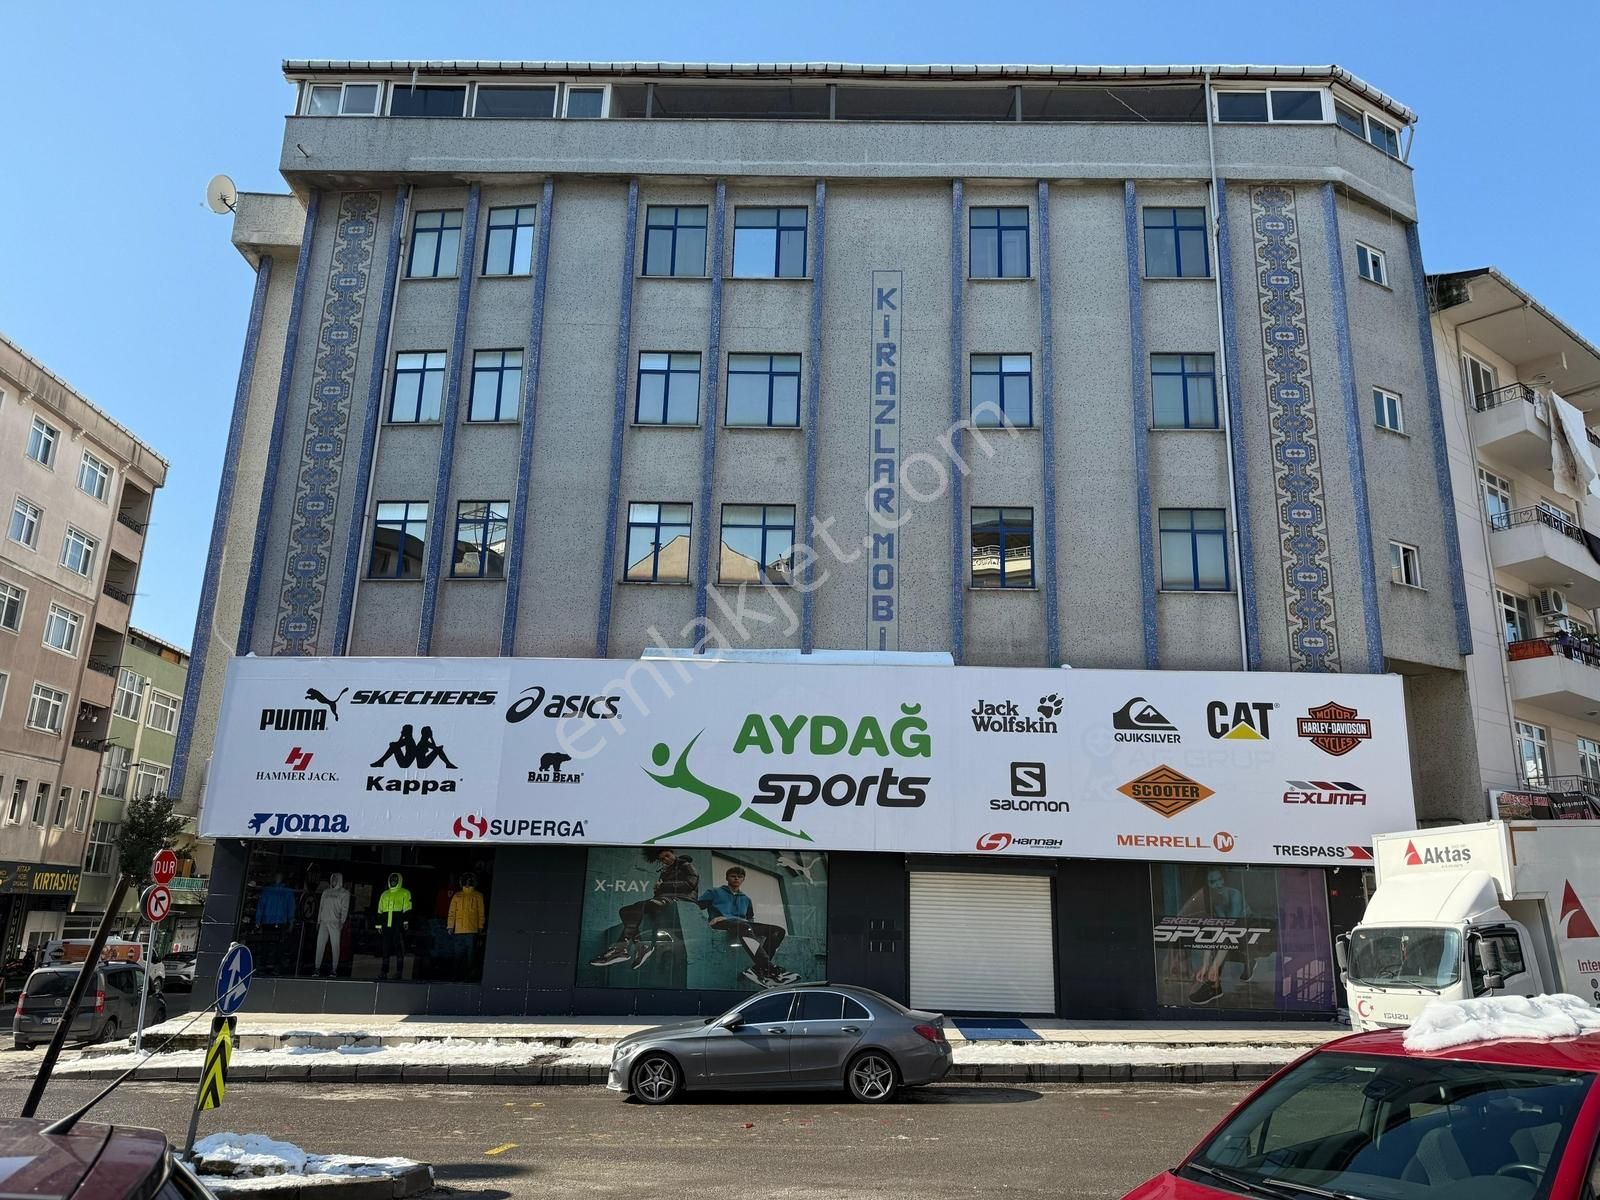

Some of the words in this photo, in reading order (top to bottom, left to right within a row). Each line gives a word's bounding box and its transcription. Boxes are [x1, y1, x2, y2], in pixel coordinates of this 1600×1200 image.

[350, 690, 498, 706] SKECHERS
[971, 699, 1019, 716] Jack
[1316, 706, 1351, 720] MOTOR
[259, 708, 328, 731] PUMA
[971, 715, 1058, 734] Wolfskin
[1206, 700, 1274, 740] CAT
[732, 702, 932, 758] AYDAĞ
[1301, 721, 1367, 735] HARLEY-DAVIDSON
[1113, 732, 1182, 744] QUIKSILVER
[1318, 737, 1353, 752] CYCLES
[256, 771, 306, 781] HAMMER
[307, 772, 337, 782] JACK
[365, 775, 457, 795] Kappa
[1131, 784, 1200, 798] SCOOTER
[750, 767, 932, 822] sports
[1282, 791, 1367, 806] EXUMA
[489, 819, 585, 837] SUPERGA
[1116, 834, 1211, 849] MERRELL
[1272, 844, 1346, 857] TRESPASS
[1423, 846, 1472, 865] Aktaş
[155, 860, 176, 874] DUR
[32, 869, 80, 891] KIRTASİYE
[594, 879, 650, 892] X-RAY
[1160, 917, 1237, 926] SKECHERS
[1154, 925, 1272, 945] SPORT
[1383, 1012, 1409, 1020] ISUZU
